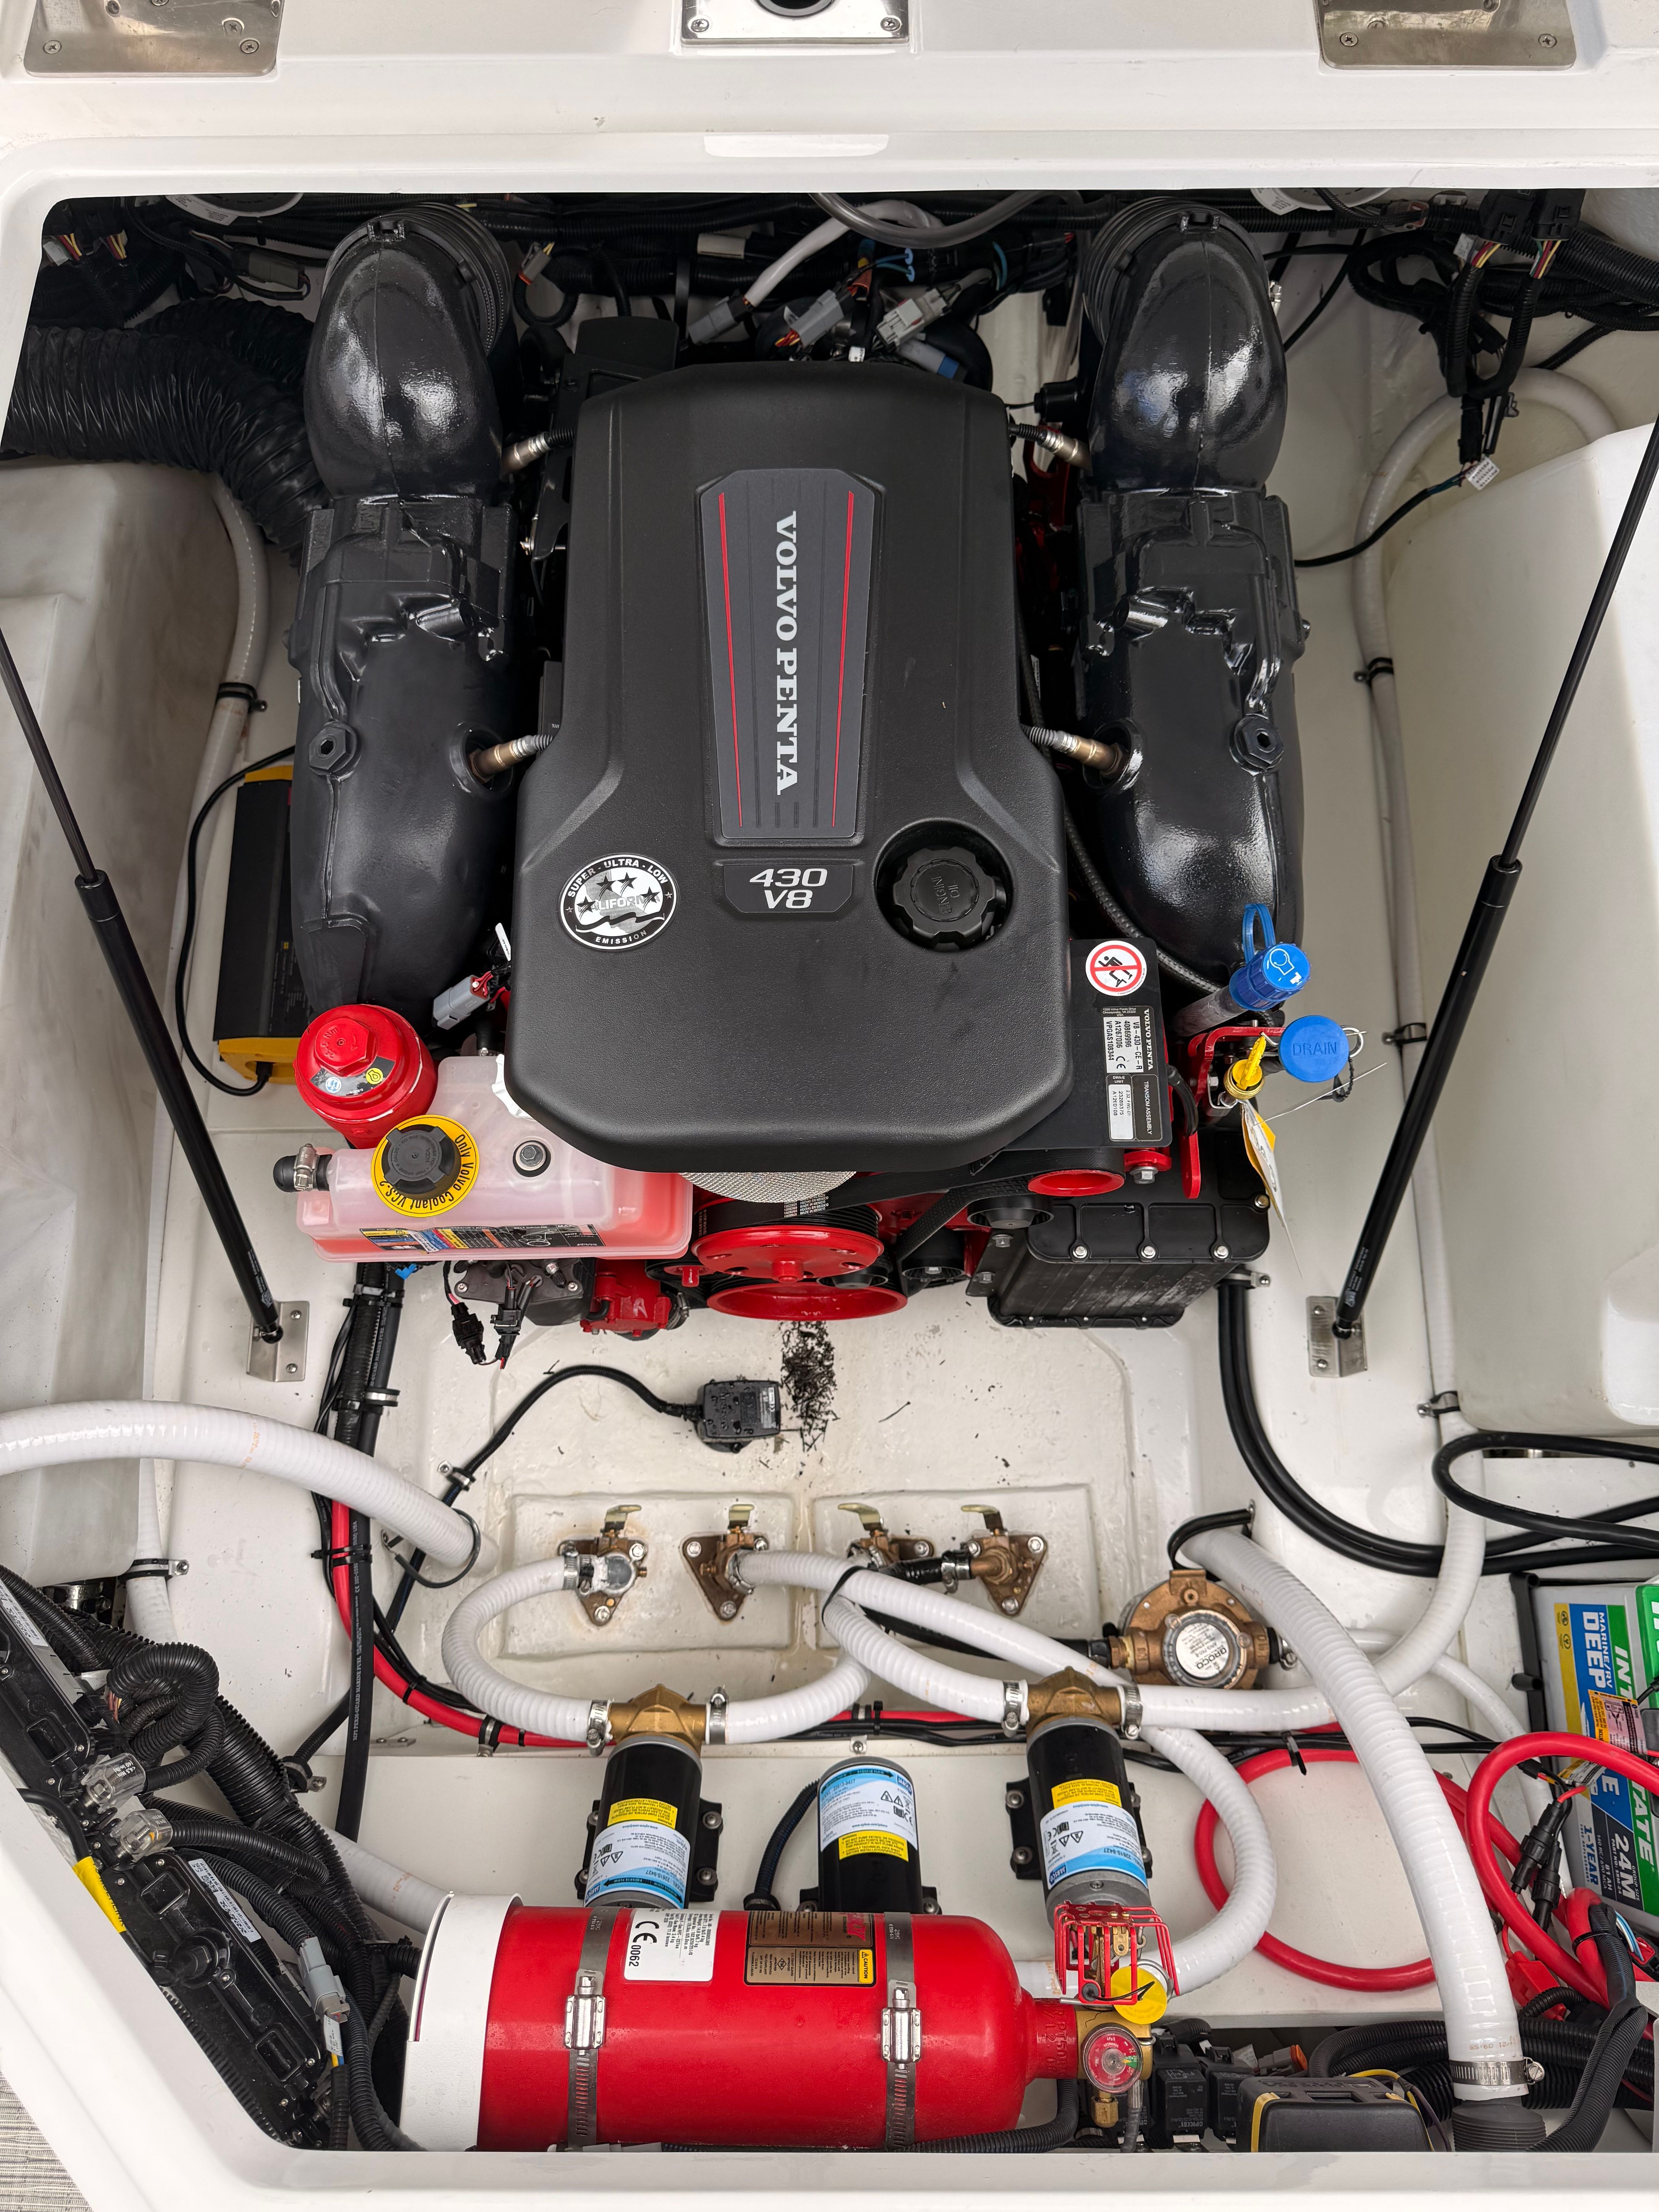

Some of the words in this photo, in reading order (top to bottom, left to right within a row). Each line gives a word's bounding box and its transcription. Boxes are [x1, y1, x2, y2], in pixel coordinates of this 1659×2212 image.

[776, 510, 797, 641] VOLVO
[776, 647, 798, 795] PENTA
[568, 868, 596, 898] SUPER
[603, 859, 639, 868] ULTRA
[647, 865, 668, 884] LOW
[749, 868, 828, 887] 430
[765, 890, 814, 909] V8
[595, 930, 647, 944] EMISSION
[1106, 1021, 1114, 1060] VPGAS108344
[1293, 1042, 1338, 1057] DRAIN
[455, 1134, 472, 1157] Only
[453, 1162, 474, 1191] Volvo
[410, 1191, 454, 1210] Coolant
[1582, 1612, 1606, 1688] DEEP
[1599, 1612, 1613, 1688] MARINE/RV
[1584, 1826, 1599, 1885] 1-YEAR
[1598, 1847, 1603, 1856] RC
[1605, 1864, 1611, 1876] 81
[1614, 1833, 1636, 1899] 24M
[1606, 1878, 1613, 1891] AH
[629, 1945, 641, 1966] 0062
